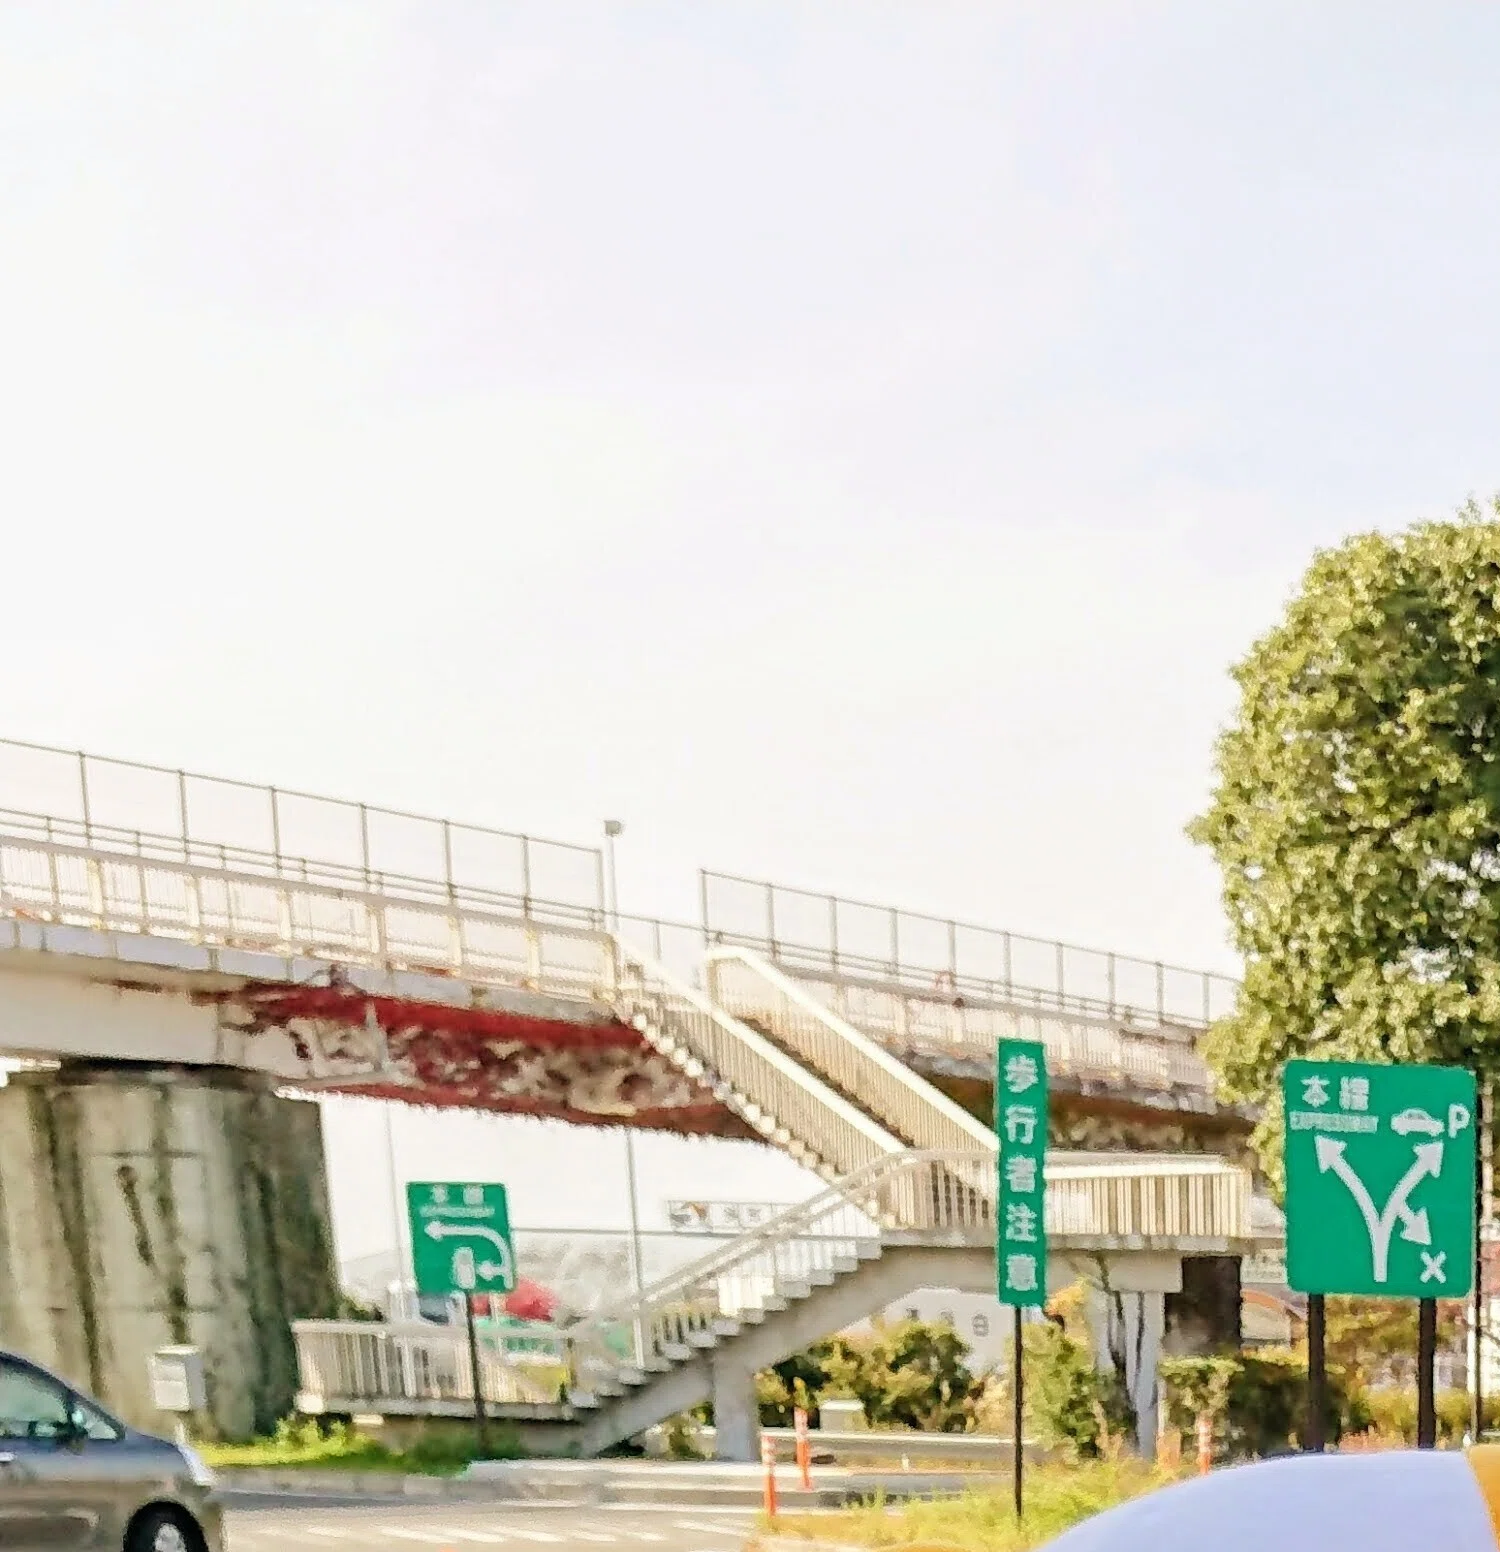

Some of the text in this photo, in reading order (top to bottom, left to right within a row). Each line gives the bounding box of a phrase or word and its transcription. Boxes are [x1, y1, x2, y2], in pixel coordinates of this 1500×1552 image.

[1004, 1053, 1038, 1291] 歩行者注意
[1448, 1103, 1470, 1138] P
